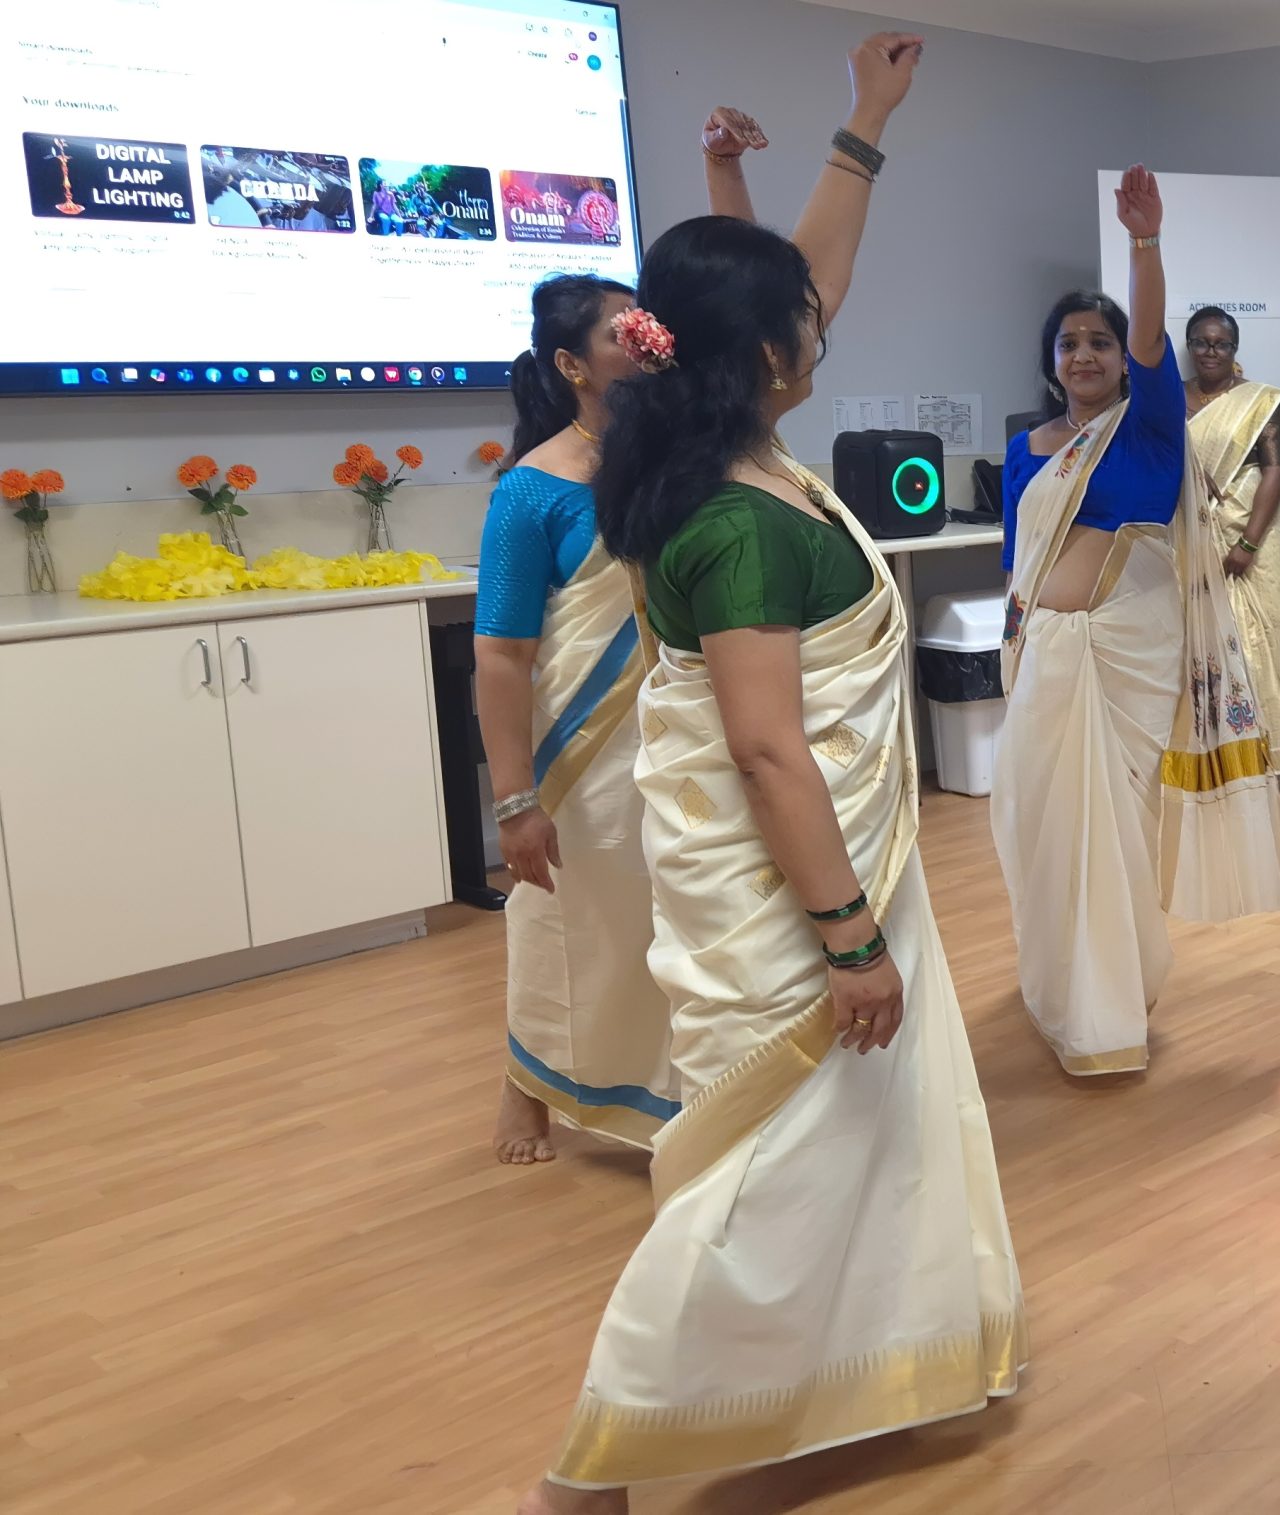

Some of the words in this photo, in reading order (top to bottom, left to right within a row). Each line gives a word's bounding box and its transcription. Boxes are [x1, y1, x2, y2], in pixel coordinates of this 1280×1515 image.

[95, 143, 172, 164] DIGITAL
[107, 166, 164, 185] LAMP
[92, 187, 184, 209] LIGHTING
[442, 201, 490, 220] Onam
[510, 206, 566, 227] Onam
[1239, 303, 1267, 312] ROOM
